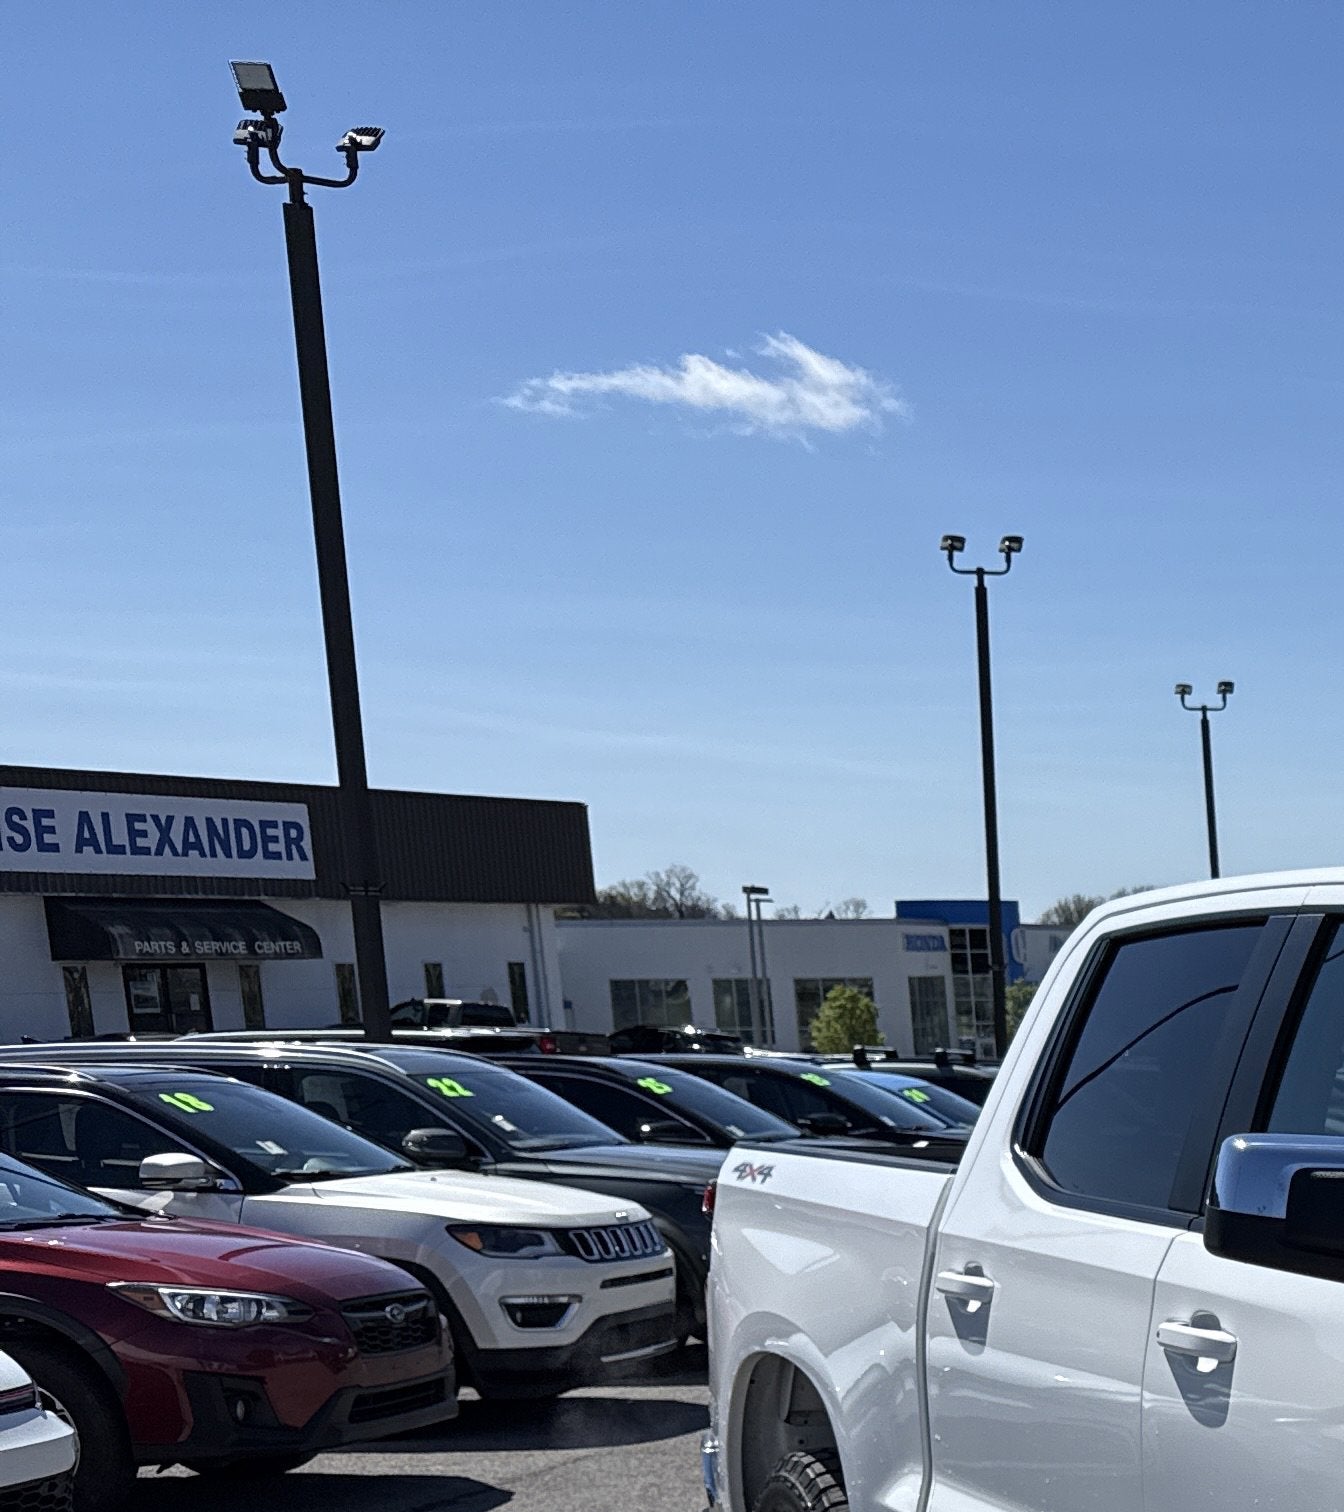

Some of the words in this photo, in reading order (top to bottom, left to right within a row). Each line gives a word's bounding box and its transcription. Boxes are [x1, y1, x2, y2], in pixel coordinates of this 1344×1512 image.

[0, 806, 61, 854] SE
[75, 811, 309, 861] ALEXANDER
[135, 941, 176, 954] PARTS
[181, 941, 190, 954] &
[195, 941, 247, 954] SERVICE
[255, 941, 302, 954] CENTER
